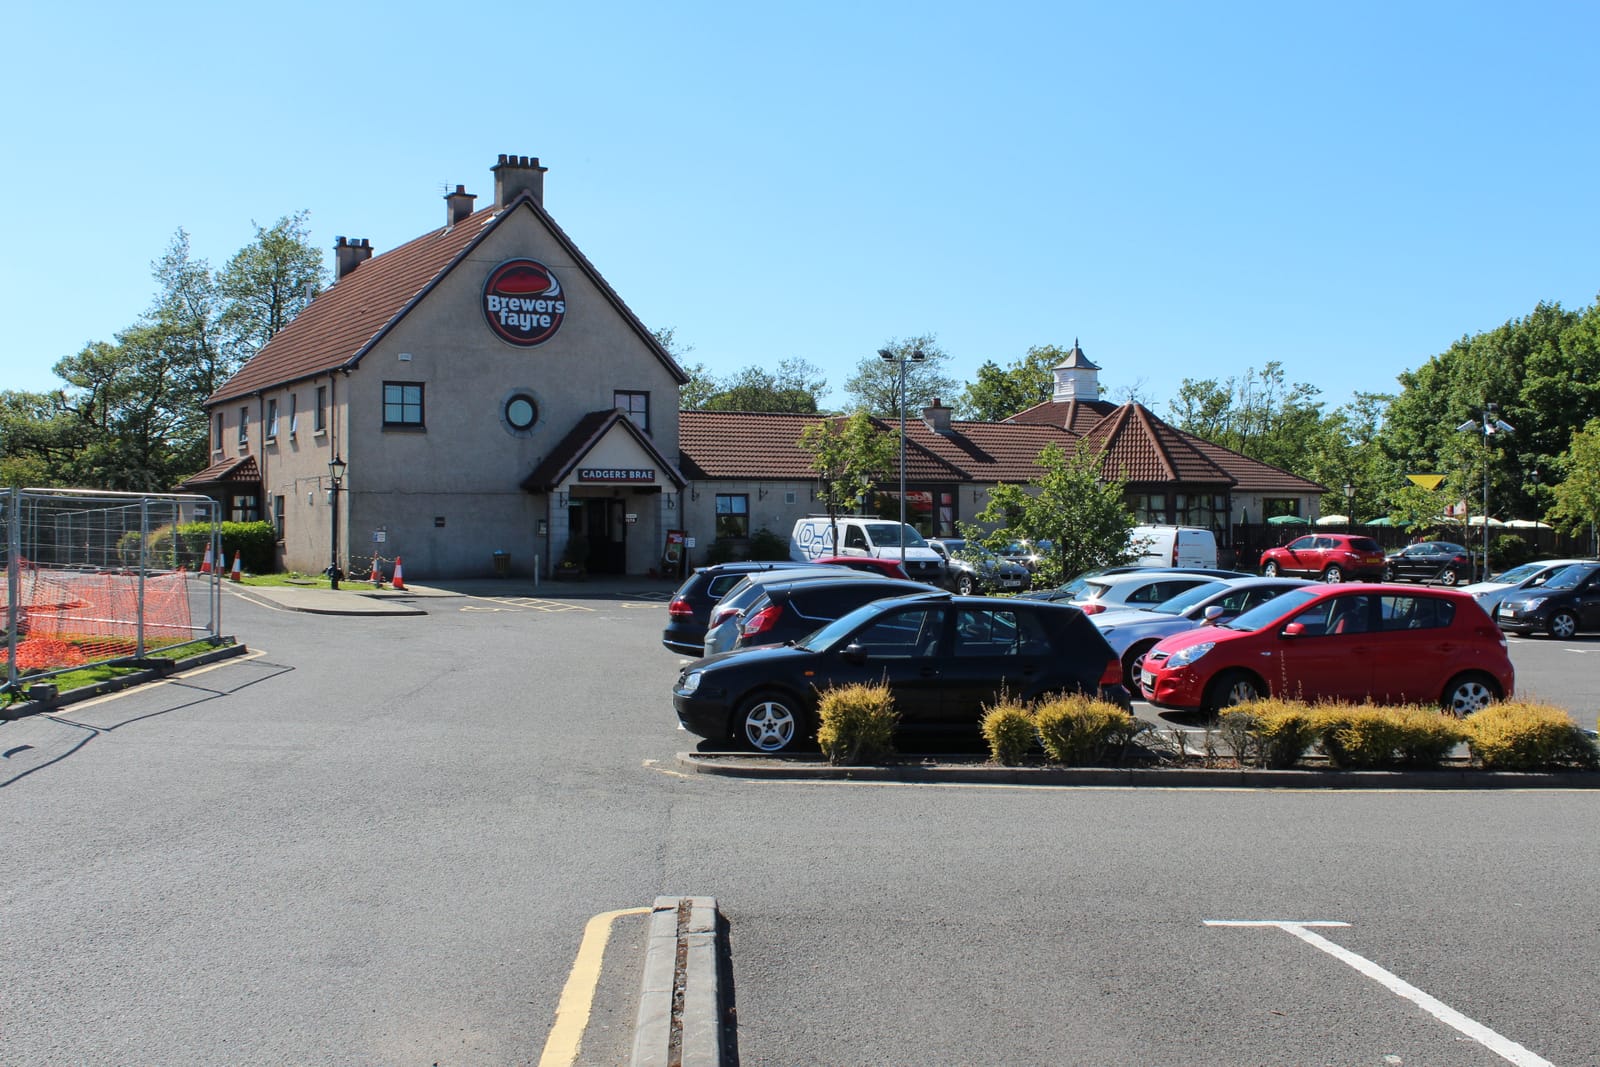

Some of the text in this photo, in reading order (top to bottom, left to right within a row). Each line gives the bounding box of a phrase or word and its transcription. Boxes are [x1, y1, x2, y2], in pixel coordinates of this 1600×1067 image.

[487, 295, 565, 313] Brewers
[499, 308, 551, 331] fayre
[582, 470, 653, 479] CADGERS BRAE
